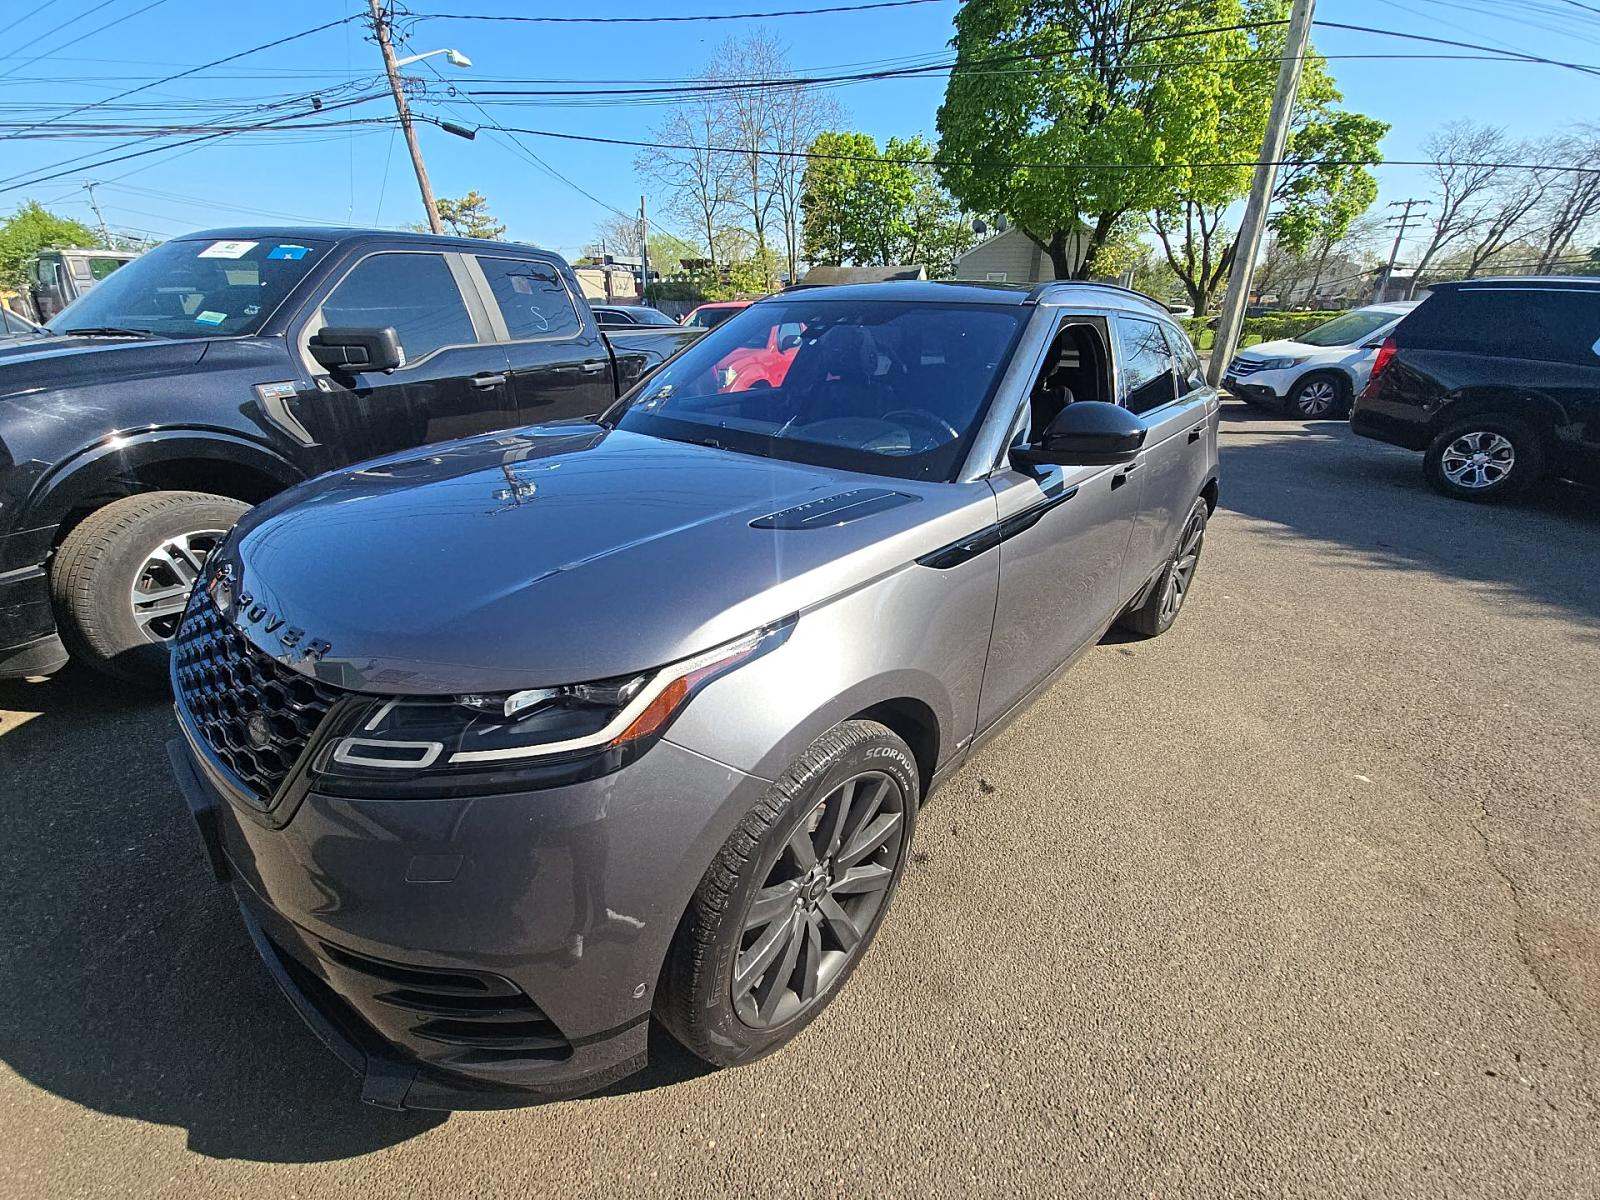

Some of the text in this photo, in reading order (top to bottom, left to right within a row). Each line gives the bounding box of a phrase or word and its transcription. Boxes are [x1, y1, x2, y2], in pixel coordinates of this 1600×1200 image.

[530, 306, 549, 331] S
[239, 591, 332, 661] ROVER
[863, 747, 915, 779] SCORPION
